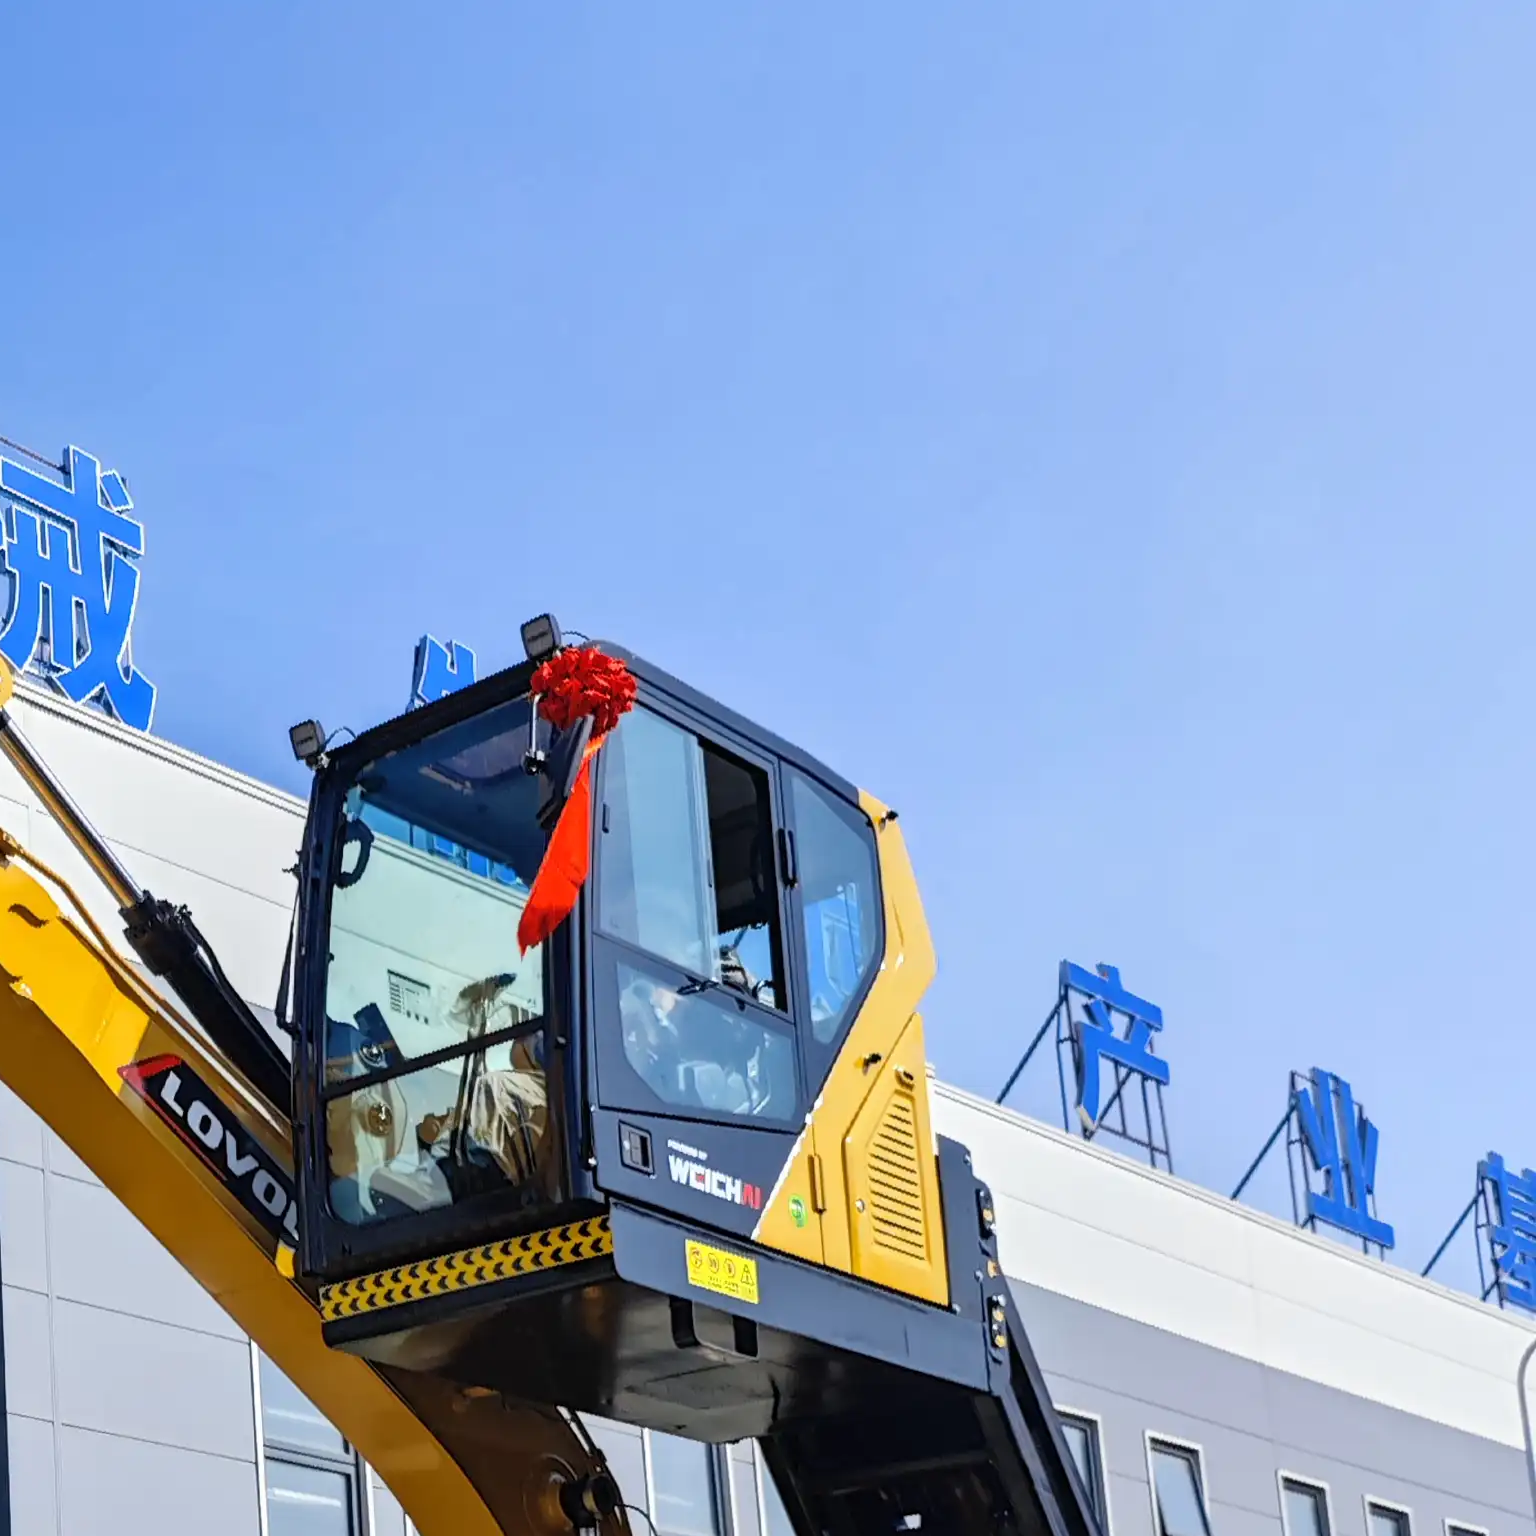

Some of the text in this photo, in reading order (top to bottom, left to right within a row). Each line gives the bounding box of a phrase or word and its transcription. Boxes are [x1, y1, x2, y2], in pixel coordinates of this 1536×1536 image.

[668, 1154, 762, 1210] WEICHAI
[1059, 958, 1170, 1132] 产
[1295, 1066, 1395, 1250] 业
